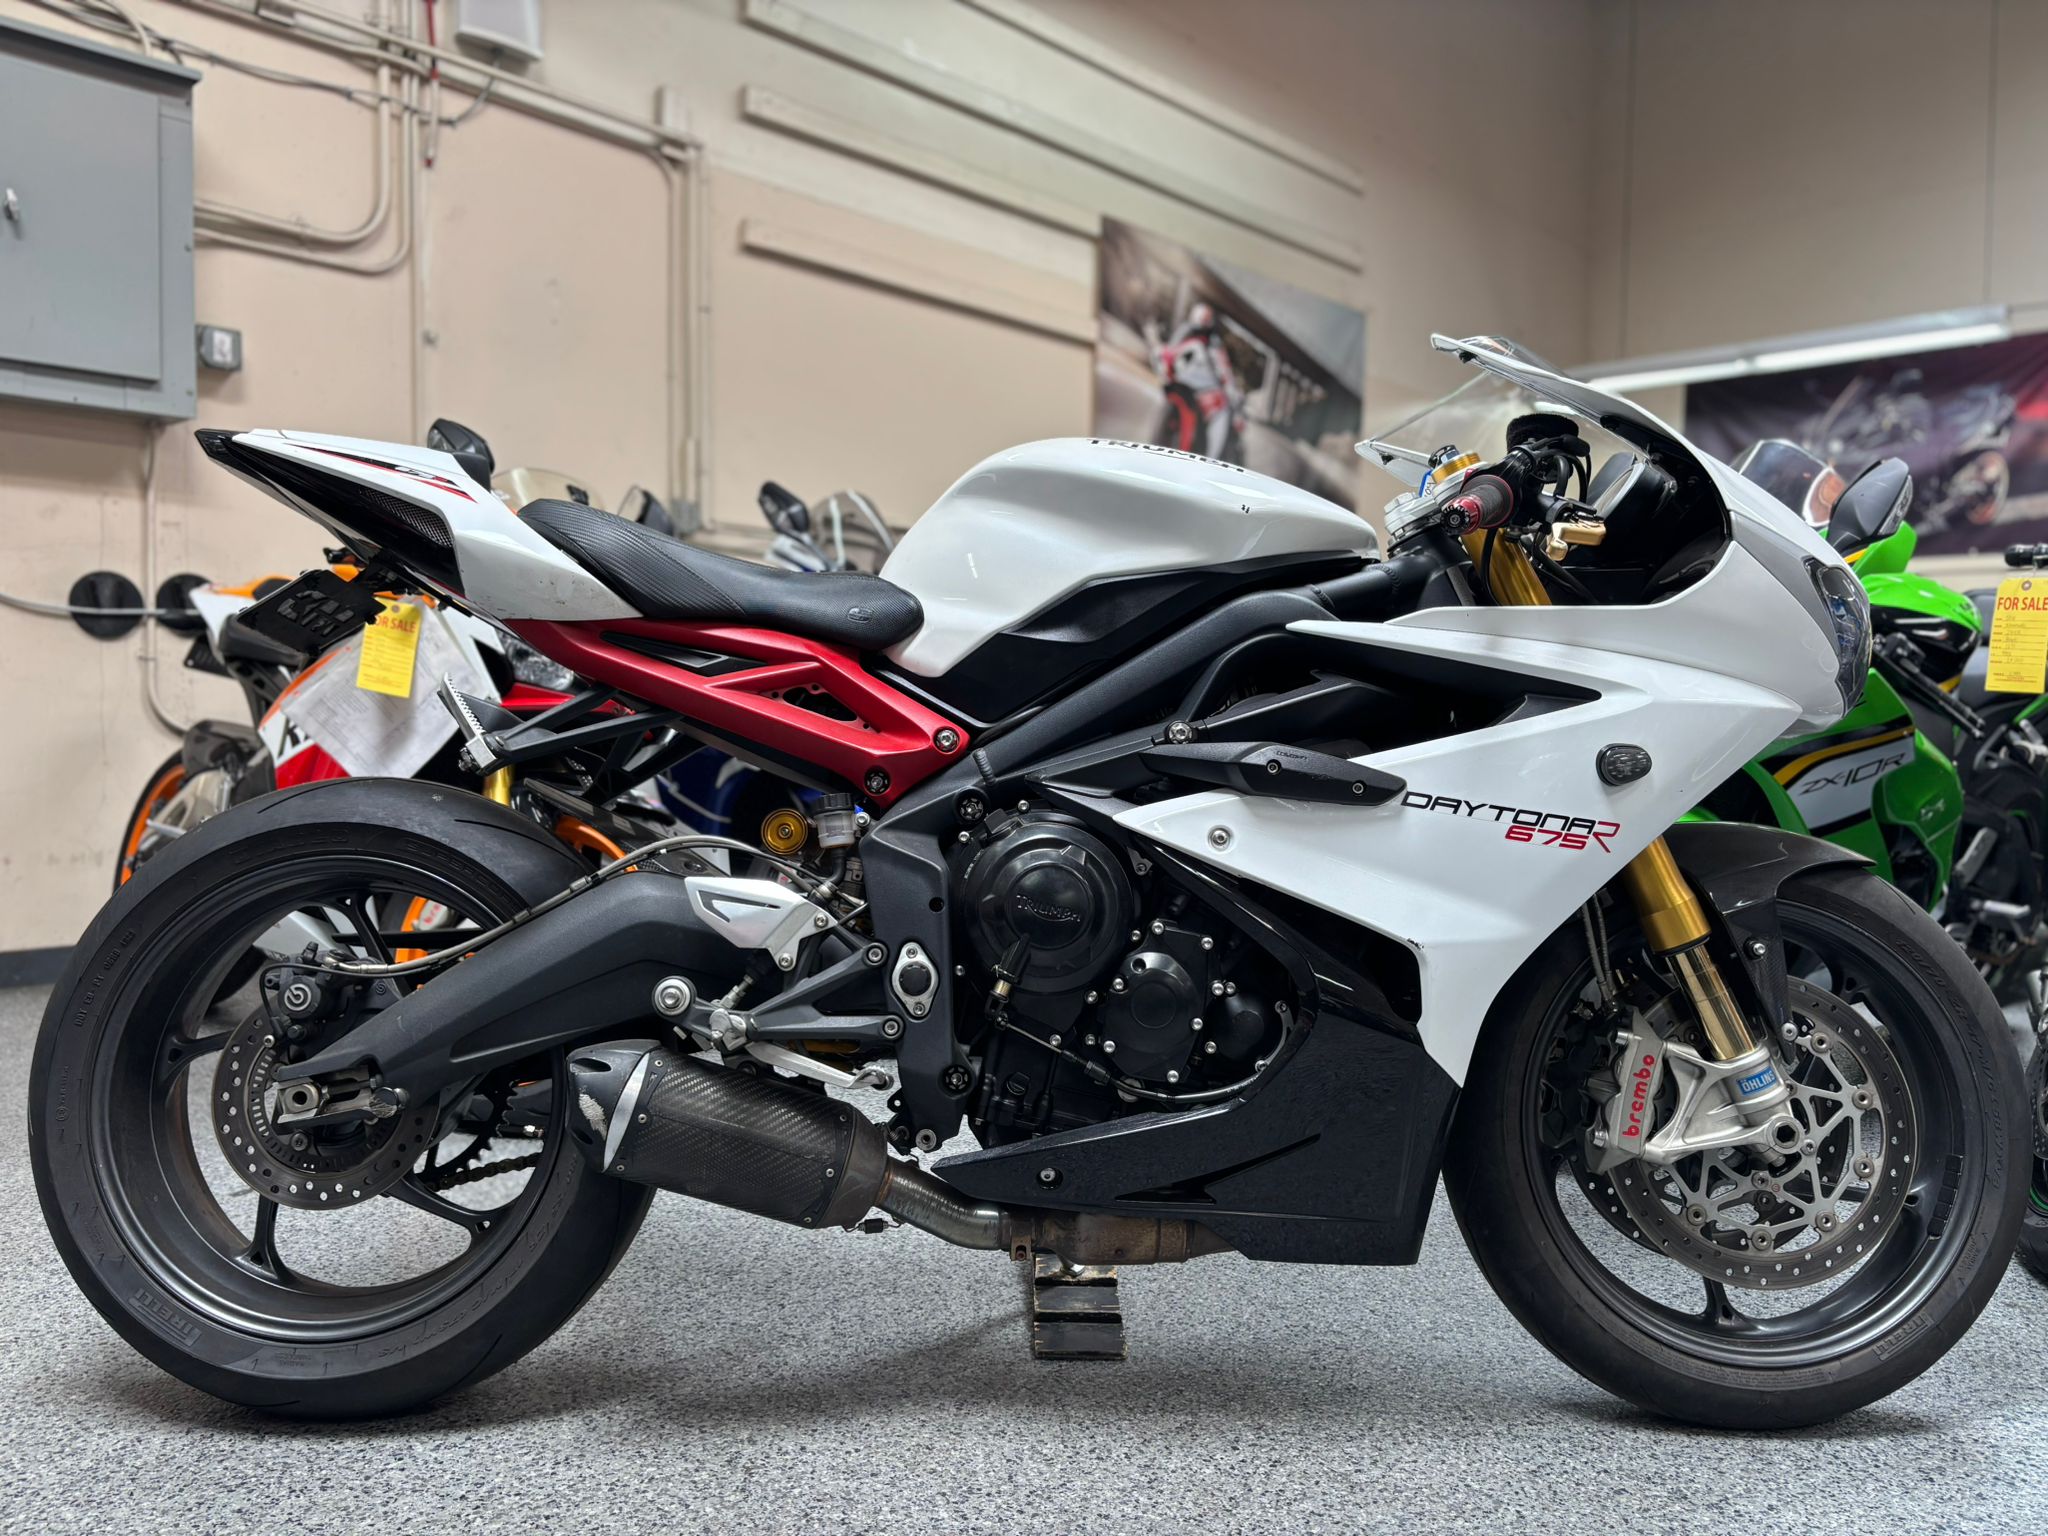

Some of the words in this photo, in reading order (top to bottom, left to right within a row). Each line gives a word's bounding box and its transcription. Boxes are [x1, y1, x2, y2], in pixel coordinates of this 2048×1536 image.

[1996, 596, 2019, 611] FOR
[2020, 597, 2048, 611] SALE
[390, 617, 417, 634] SALE
[1800, 753, 1906, 796] ZX-10R
[1400, 790, 1597, 835] DAYTONA
[1504, 820, 1621, 854] 675R
[1016, 893, 1082, 923] TRIUMPH
[1621, 1053, 1656, 1138] brembo
[1741, 1069, 1776, 1094] ÖHLINS
[128, 1288, 202, 1347] PIRELLI
[1872, 1311, 1936, 1361] PIRELLI
